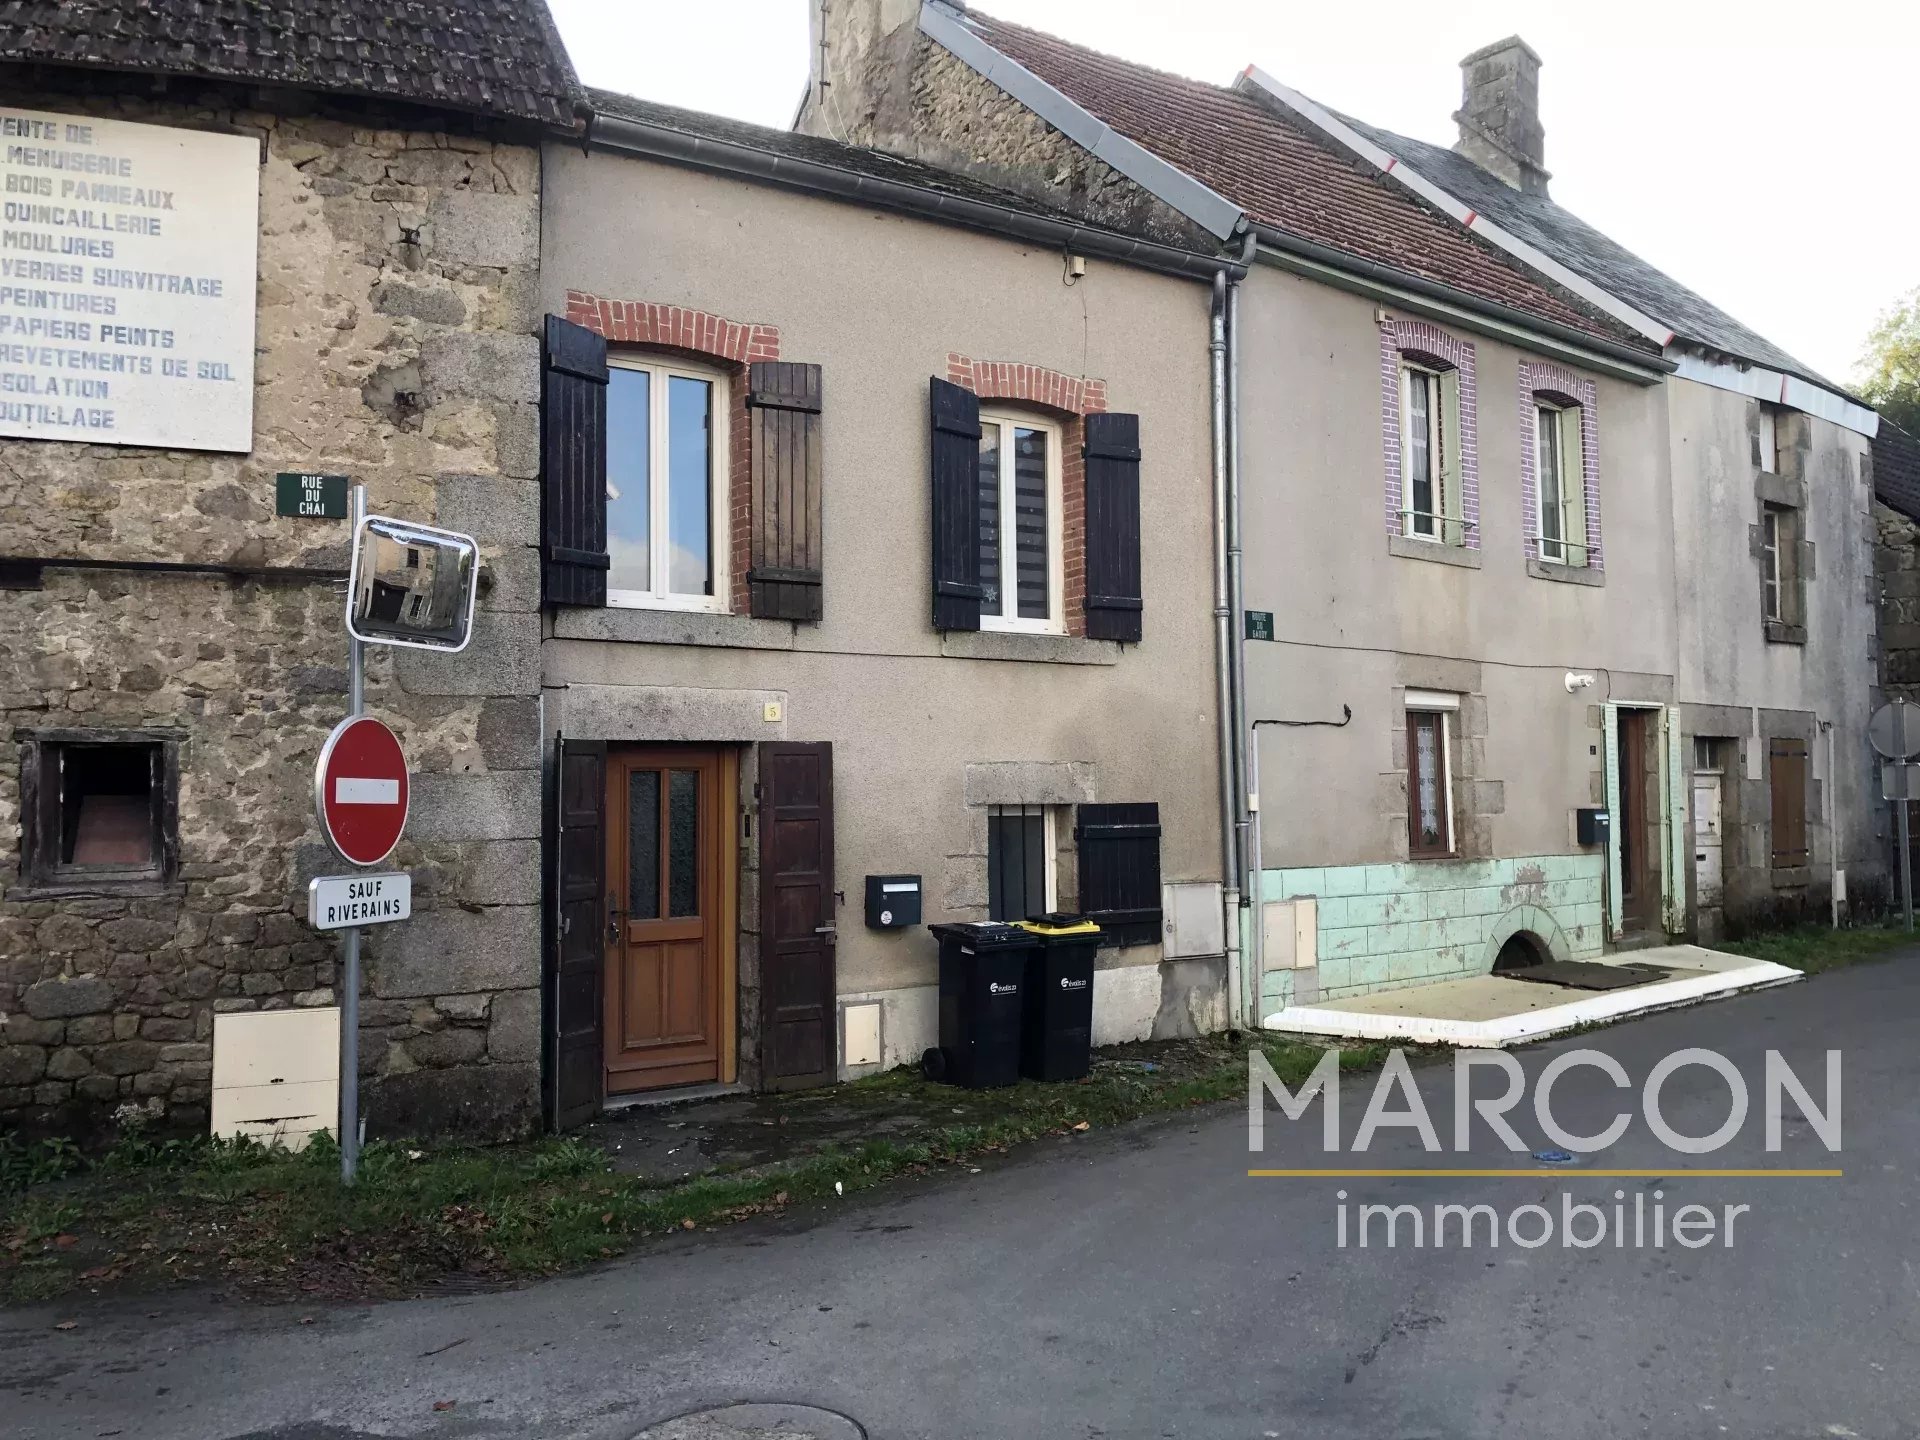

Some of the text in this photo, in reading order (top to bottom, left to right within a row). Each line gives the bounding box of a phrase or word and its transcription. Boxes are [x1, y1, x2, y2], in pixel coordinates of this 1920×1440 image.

[65, 123, 92, 145] DE
[5, 173, 174, 210] BOIS PANNEAUX
[4, 202, 161, 236] QUINCAILLERIE
[3, 230, 114, 259] MOULURES
[1, 258, 223, 298] VERRES SURVITRAGE
[0, 286, 116, 315] PEINTURES
[0, 315, 174, 348] PAPIERS PEINTS
[161, 357, 188, 378] DE
[197, 361, 236, 382] SOL
[301, 475, 323, 490] RUE
[305, 489, 320, 503] DU
[299, 501, 325, 516] CHAI
[770, 706, 777, 718] 5
[349, 880, 382, 900] SAUF
[327, 899, 400, 923] RIVERAINS
